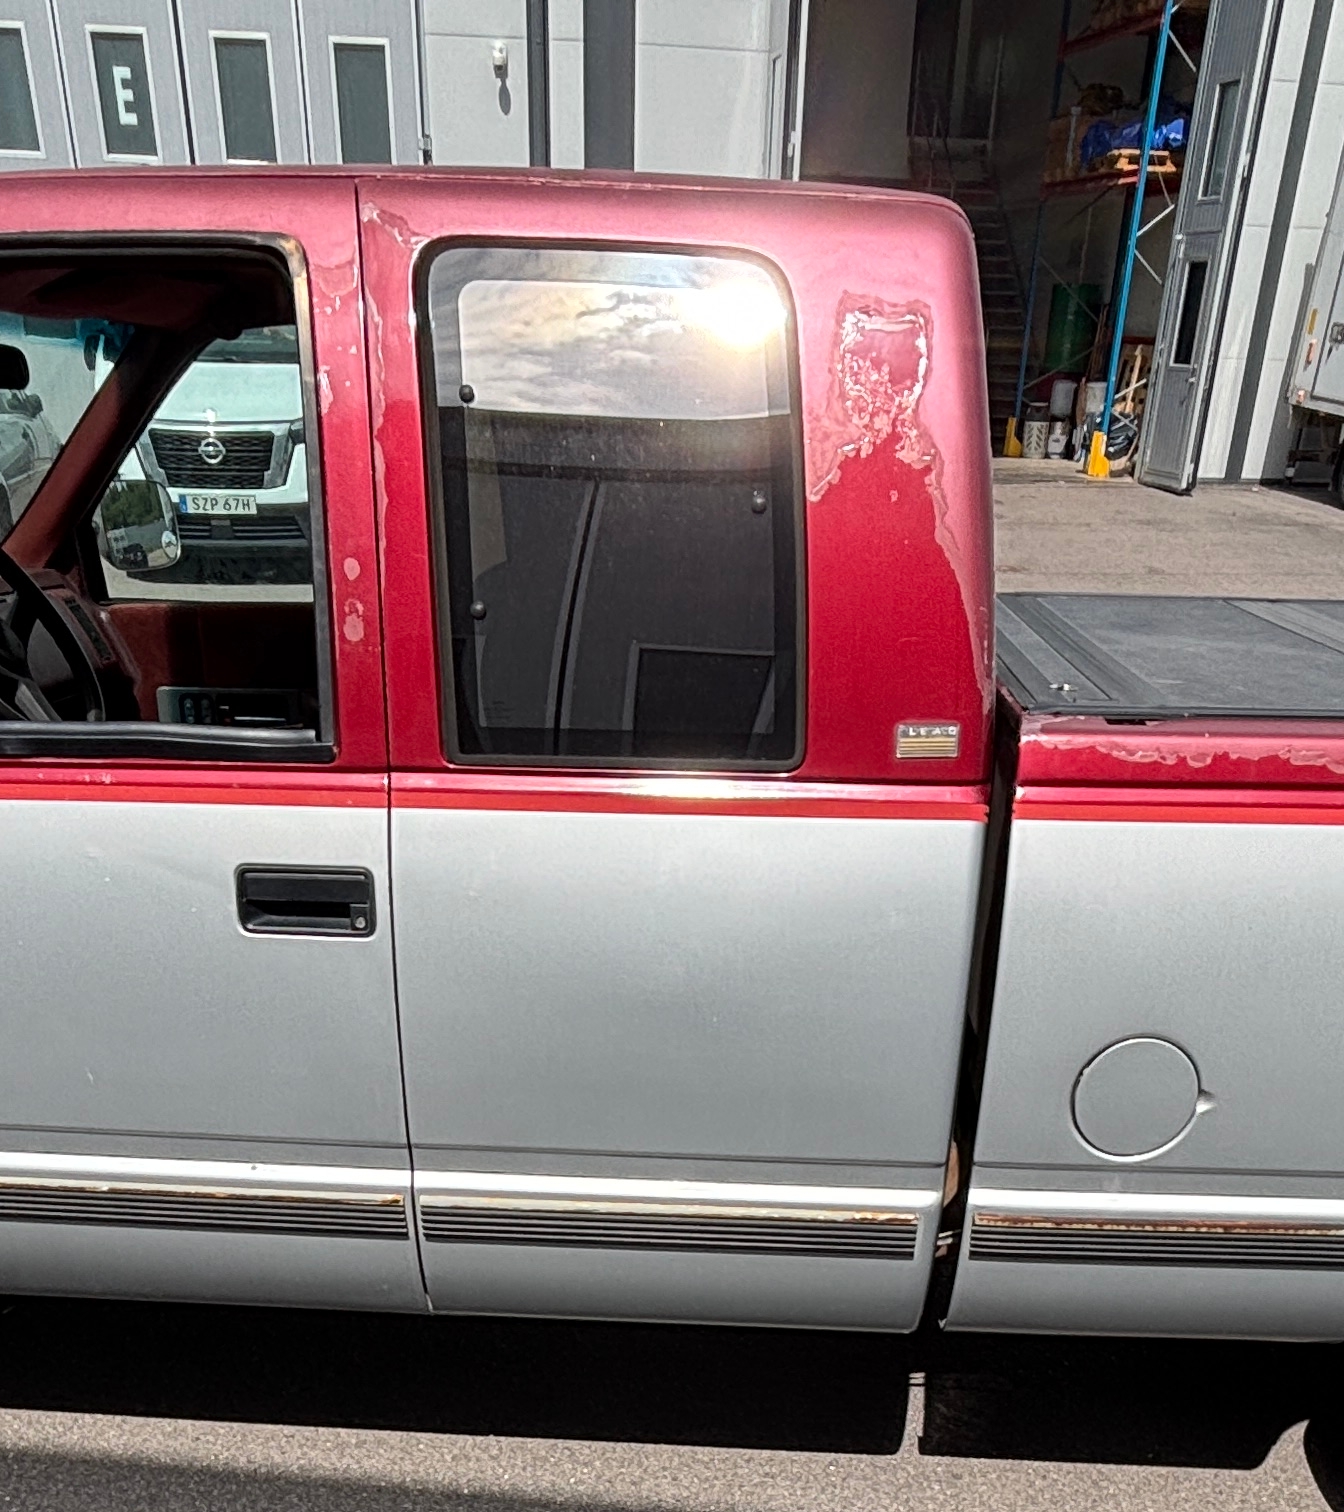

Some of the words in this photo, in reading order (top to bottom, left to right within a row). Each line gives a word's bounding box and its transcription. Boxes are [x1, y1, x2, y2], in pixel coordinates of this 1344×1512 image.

[112, 65, 138, 125] E
[192, 497, 219, 511] SZP
[222, 498, 251, 511] 67H
